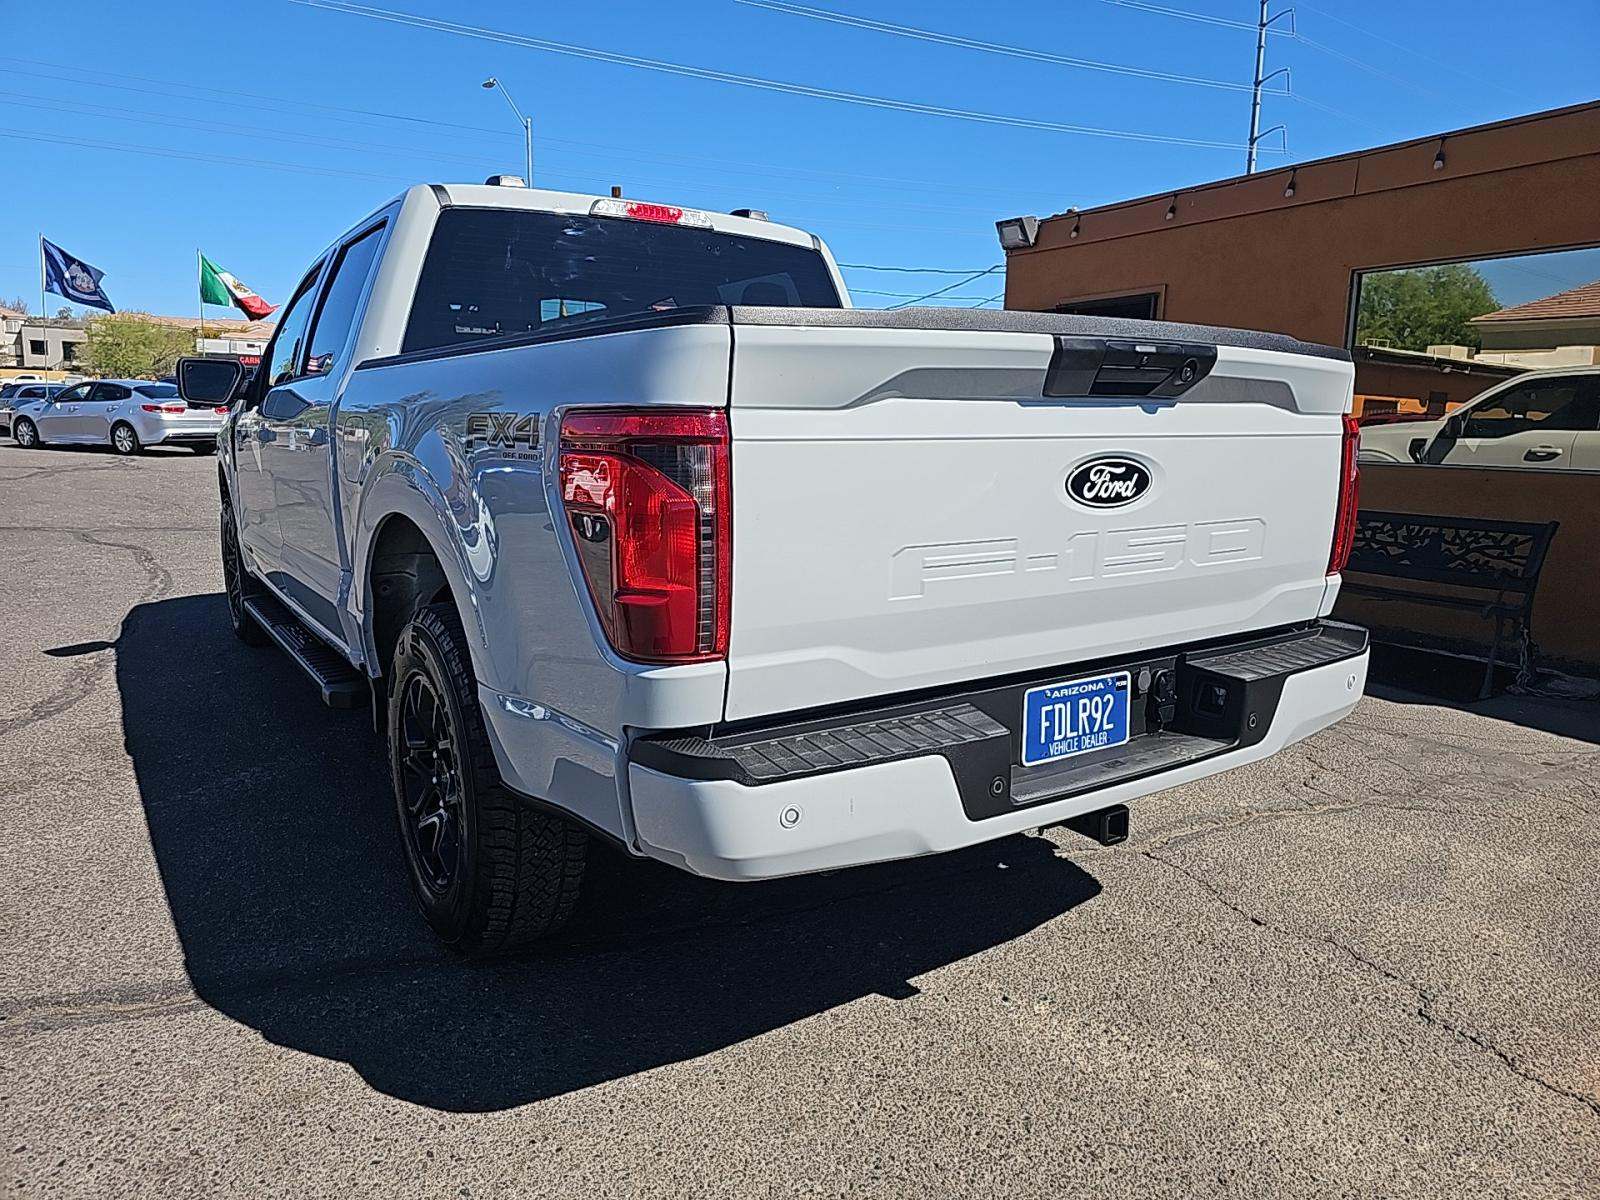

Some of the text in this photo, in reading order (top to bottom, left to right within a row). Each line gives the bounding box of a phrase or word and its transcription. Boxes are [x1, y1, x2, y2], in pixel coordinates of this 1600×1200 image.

[465, 412, 541, 454] FX4
[518, 453, 538, 461] ROAD
[1083, 465, 1137, 500] Ford
[888, 517, 1267, 601] F-150
[1051, 682, 1104, 698] ARIZONA
[1040, 693, 1115, 744] FDLR92
[1048, 732, 1108, 756] VEHICLE DEALER
